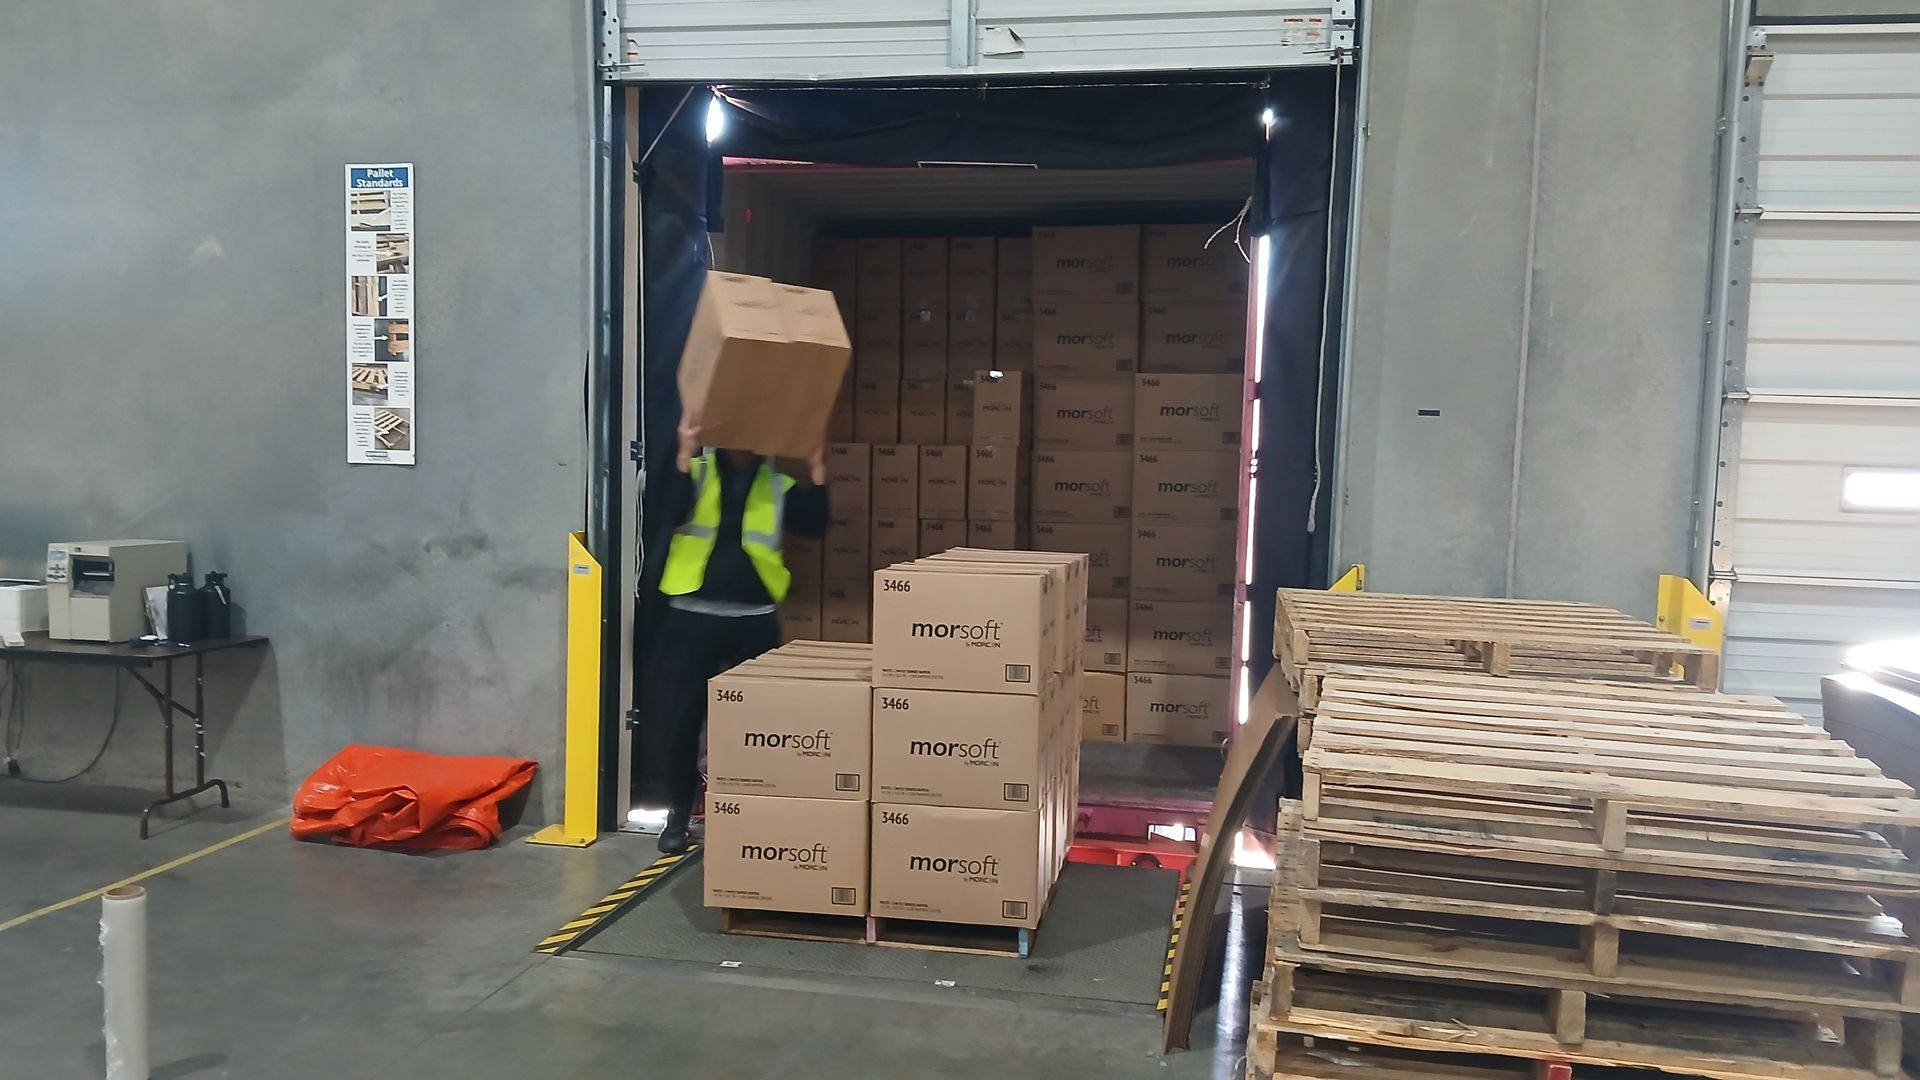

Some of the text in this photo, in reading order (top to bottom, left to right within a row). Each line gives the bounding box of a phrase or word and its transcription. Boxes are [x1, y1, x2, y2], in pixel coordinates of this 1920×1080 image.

[367, 168, 395, 178] Pallet
[356, 178, 404, 187] Standards
[1056, 330, 1115, 345] morsoft
[1056, 406, 1114, 420] morsoft
[1160, 402, 1221, 417] morsoft
[1054, 479, 1112, 493] morsoft
[1157, 480, 1219, 494] morsoft
[1155, 555, 1217, 569] morsoft
[883, 579, 911, 593] 3466
[911, 619, 1002, 641] morsoft
[1153, 627, 1214, 642] morsoft
[1133, 676, 1153, 685] 3466
[716, 689, 744, 703] 3466
[882, 697, 910, 711] 3466
[1150, 701, 1211, 715] morsoft
[744, 730, 832, 750] morsoft
[910, 738, 1001, 760] morsoft
[713, 801, 741, 815] 3466
[882, 811, 909, 826] 3466
[741, 843, 828, 864] morsoft
[909, 855, 1000, 877] morsoft
